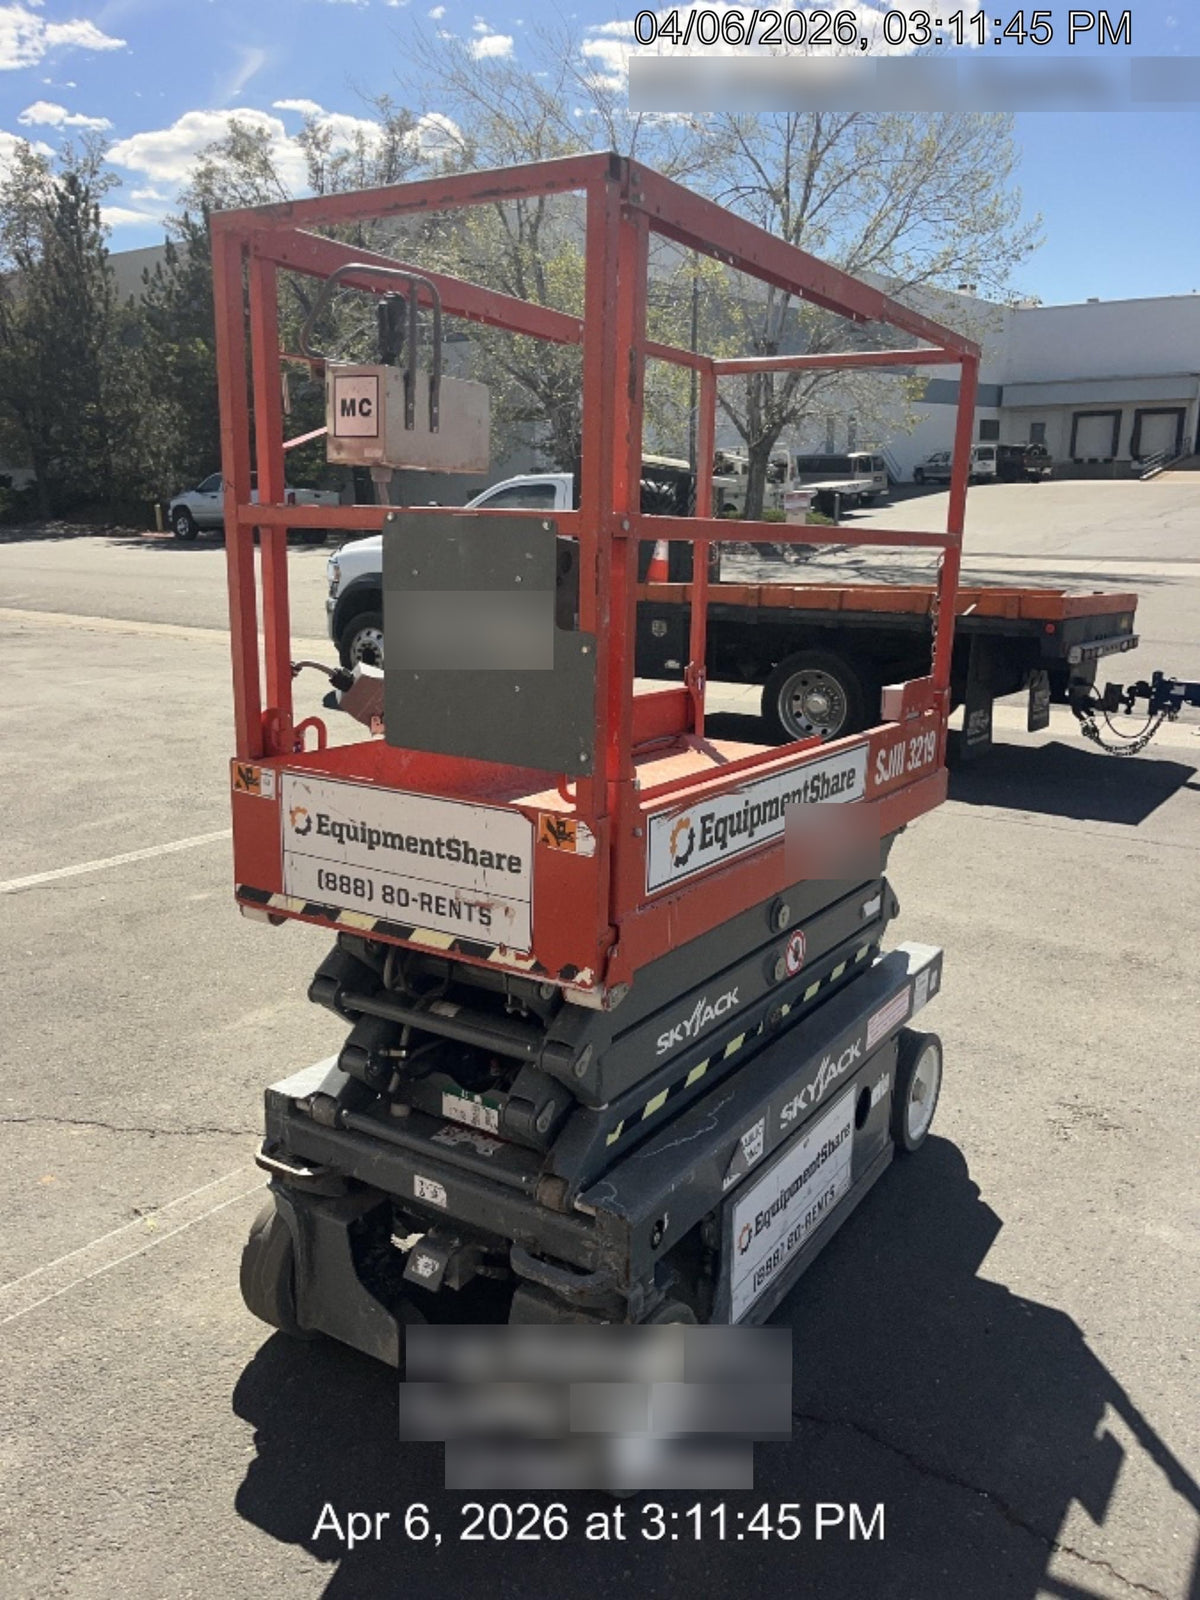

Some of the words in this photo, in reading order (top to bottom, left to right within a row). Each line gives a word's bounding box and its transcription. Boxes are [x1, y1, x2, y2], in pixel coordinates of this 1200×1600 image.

[341, 398, 372, 417] MC
[907, 730, 935, 771] 3219
[316, 813, 522, 874] EquipmentShare
[317, 868, 373, 901] (888)
[382, 884, 492, 927] 80-RENTS
[656, 987, 739, 1055] SKYJACK
[780, 1038, 861, 1128] SKYJACK
[754, 1123, 850, 1237] EquipmentShare
